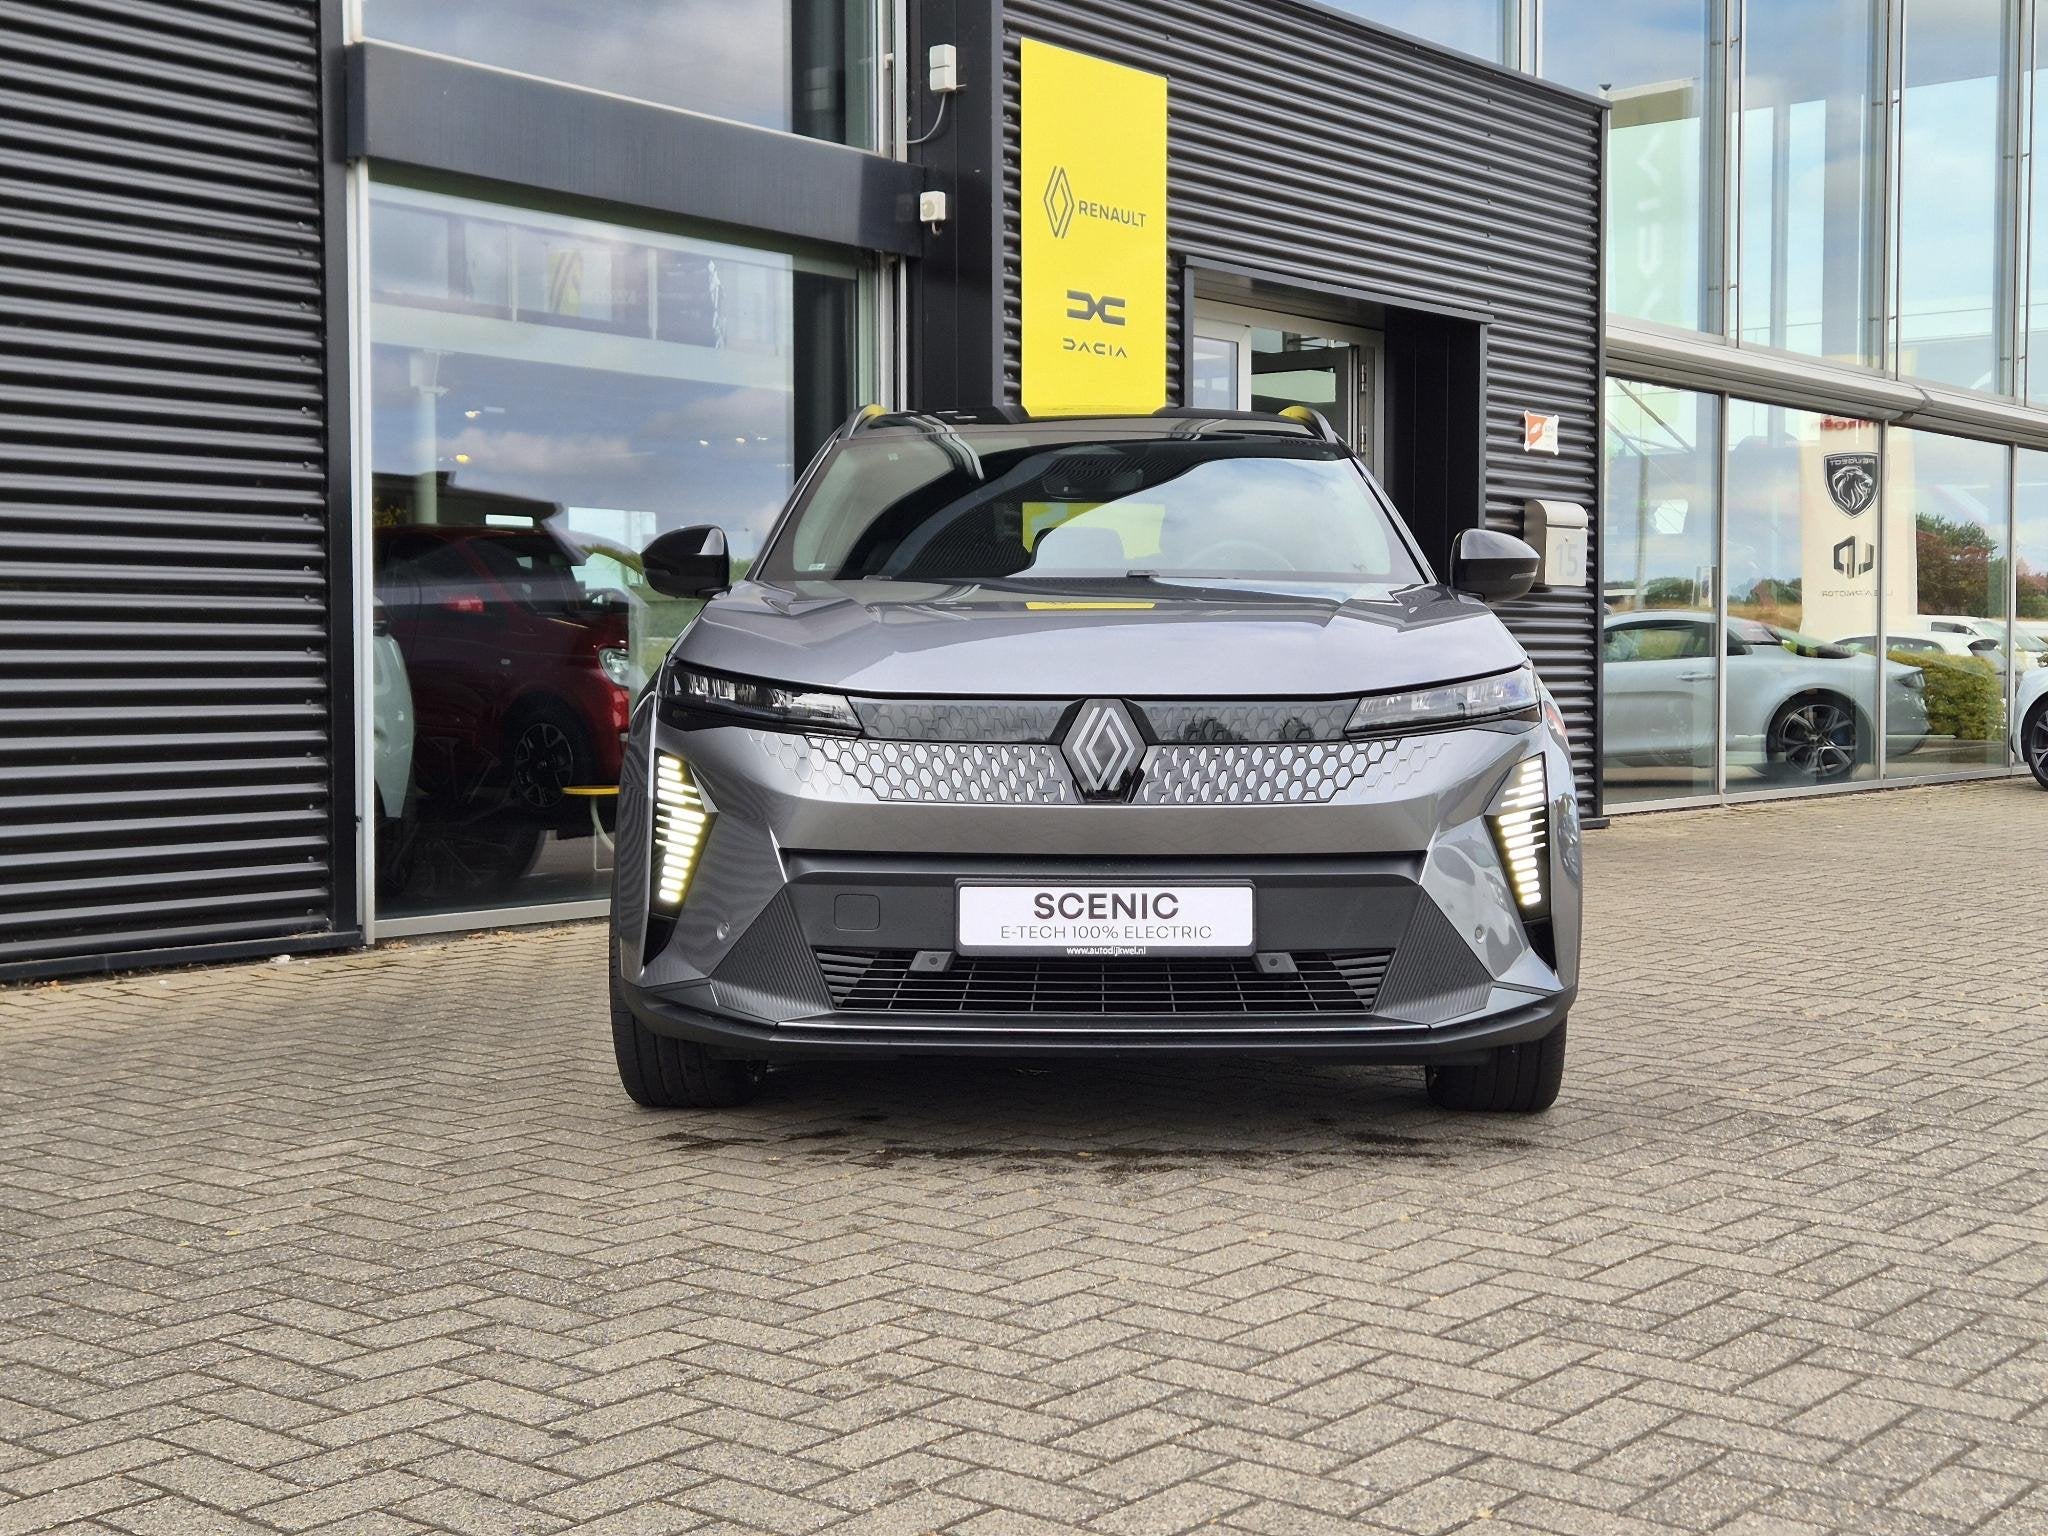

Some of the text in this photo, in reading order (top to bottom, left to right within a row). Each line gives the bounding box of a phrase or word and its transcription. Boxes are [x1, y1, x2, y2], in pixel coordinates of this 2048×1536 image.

[1078, 200, 1147, 227] RENAULT
[1063, 337, 1127, 358] DACIA
[1556, 543, 1579, 577] 15
[1033, 892, 1180, 920] SCENIC
[1000, 925, 1212, 940] E-TECH 100% ELECTRIC
[1066, 946, 1146, 957] www.autodijkwel.nl
